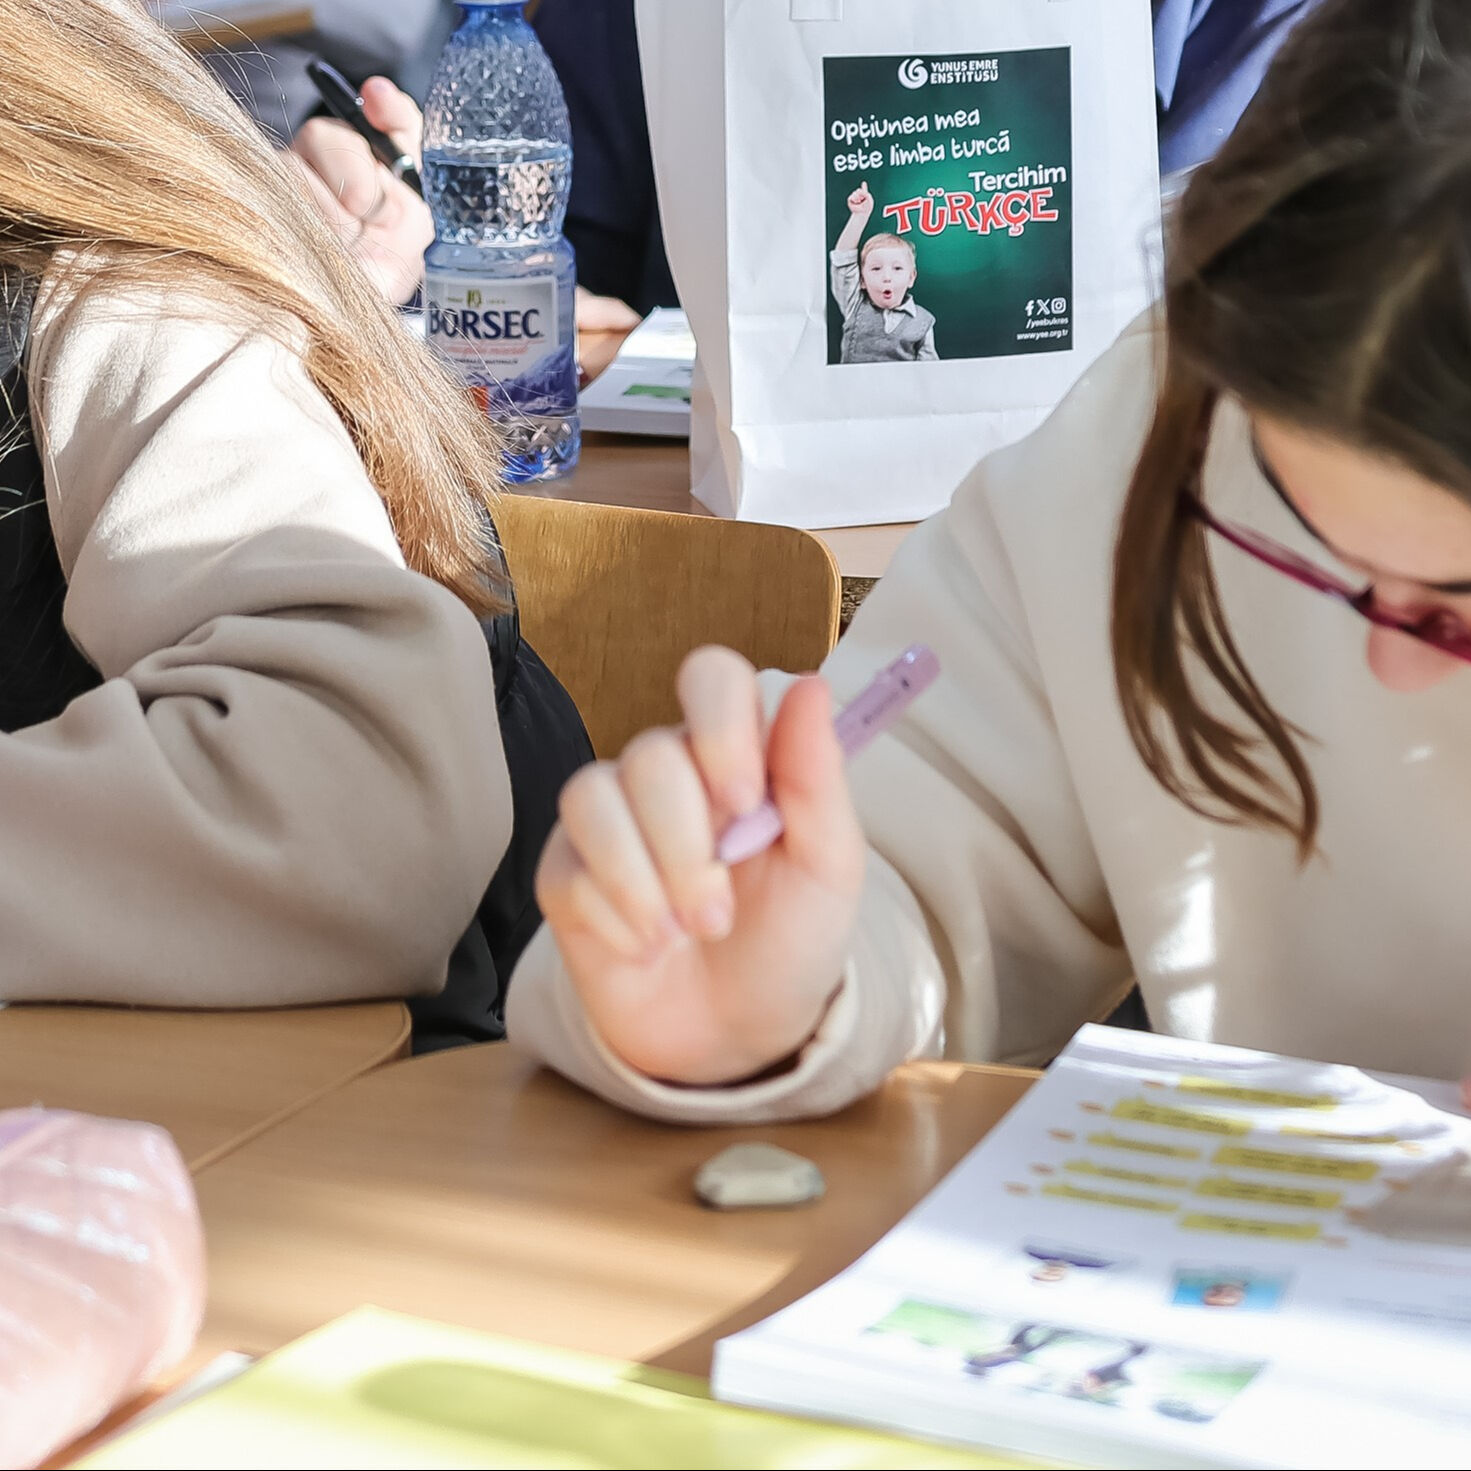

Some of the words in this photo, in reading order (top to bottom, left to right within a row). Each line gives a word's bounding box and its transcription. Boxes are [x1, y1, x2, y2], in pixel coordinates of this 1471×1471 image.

[931, 61, 967, 72] YUNUS
[969, 59, 998, 70] EMRE
[934, 108, 981, 131] mea
[833, 148, 883, 172] este
[890, 142, 945, 166] limba
[968, 164, 1066, 192] Tercihim
[883, 187, 1058, 237] TÜRKÇE
[429, 301, 541, 340] BORSEC
